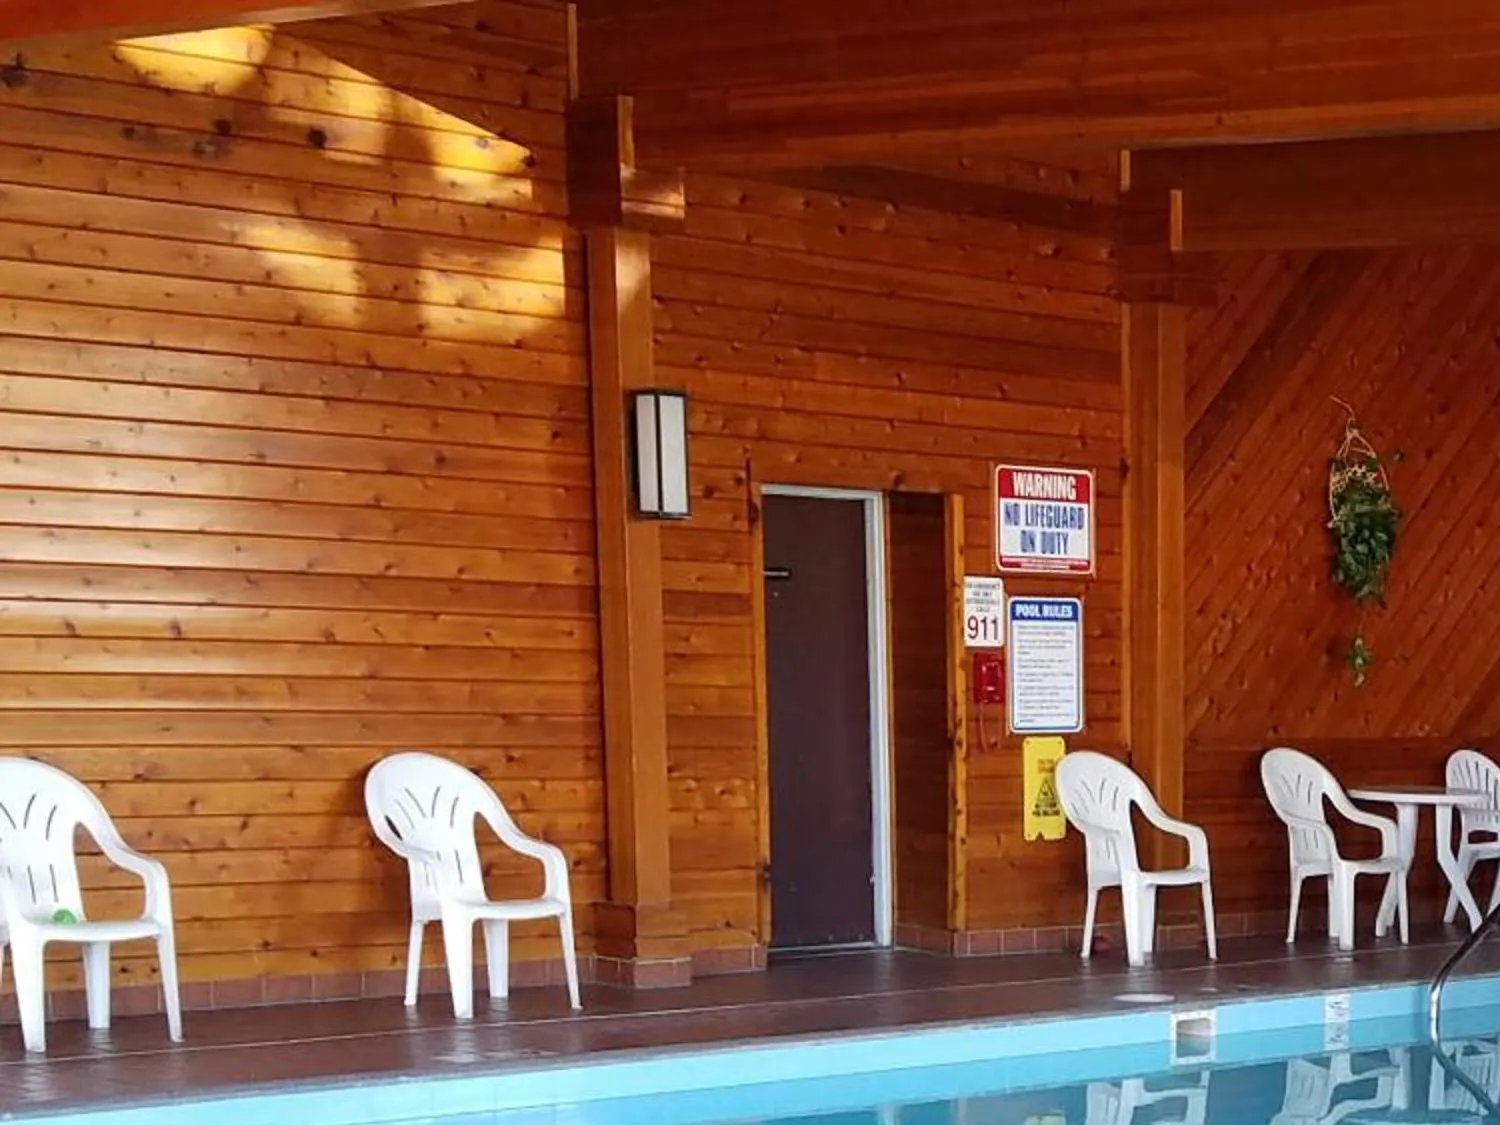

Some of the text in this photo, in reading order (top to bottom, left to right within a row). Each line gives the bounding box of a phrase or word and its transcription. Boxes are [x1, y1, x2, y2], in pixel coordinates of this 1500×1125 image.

[1012, 471, 1077, 500] WARNING
[1004, 502, 1084, 530] NO LIFEGUARD
[1021, 530, 1069, 554] ON DUTY
[1015, 603, 1073, 618] POOL RULES
[967, 615, 999, 640] 911
